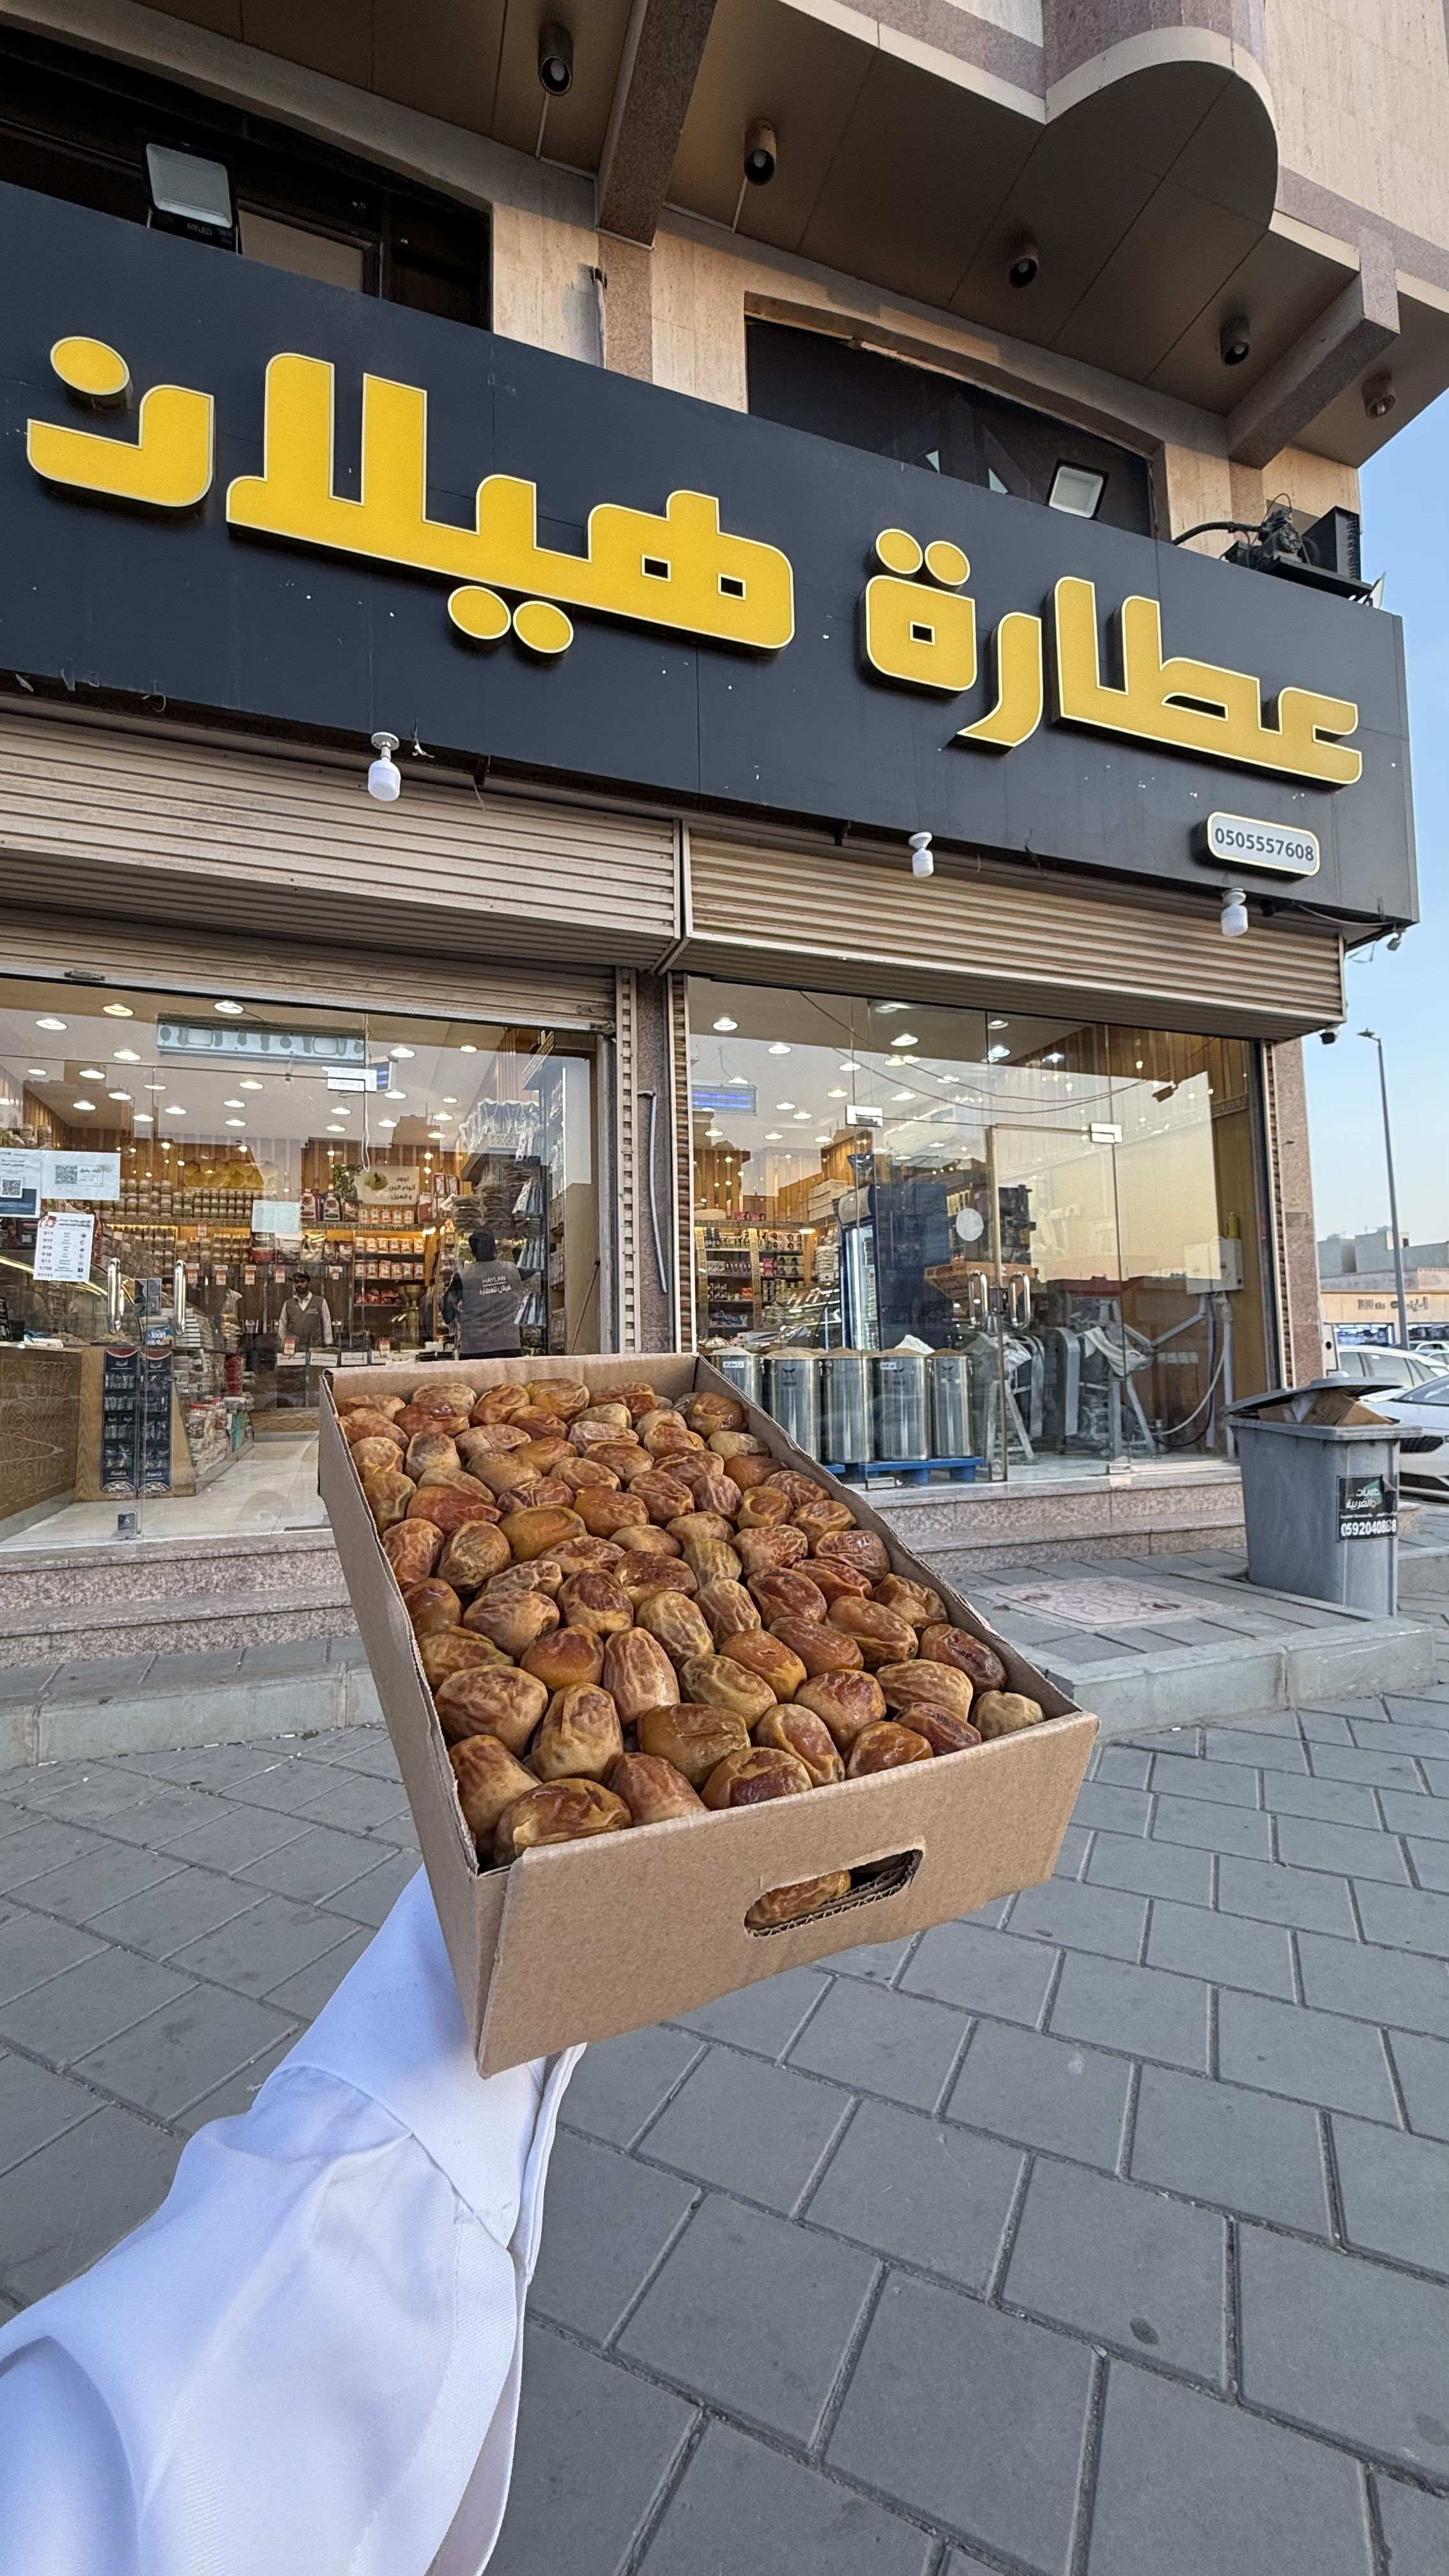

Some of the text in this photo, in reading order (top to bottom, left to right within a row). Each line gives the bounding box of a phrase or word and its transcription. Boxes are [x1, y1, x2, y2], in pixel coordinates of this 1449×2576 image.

[27, 336, 1362, 785] عطارة هيلان
[1215, 827, 1314, 861] 0505557608
